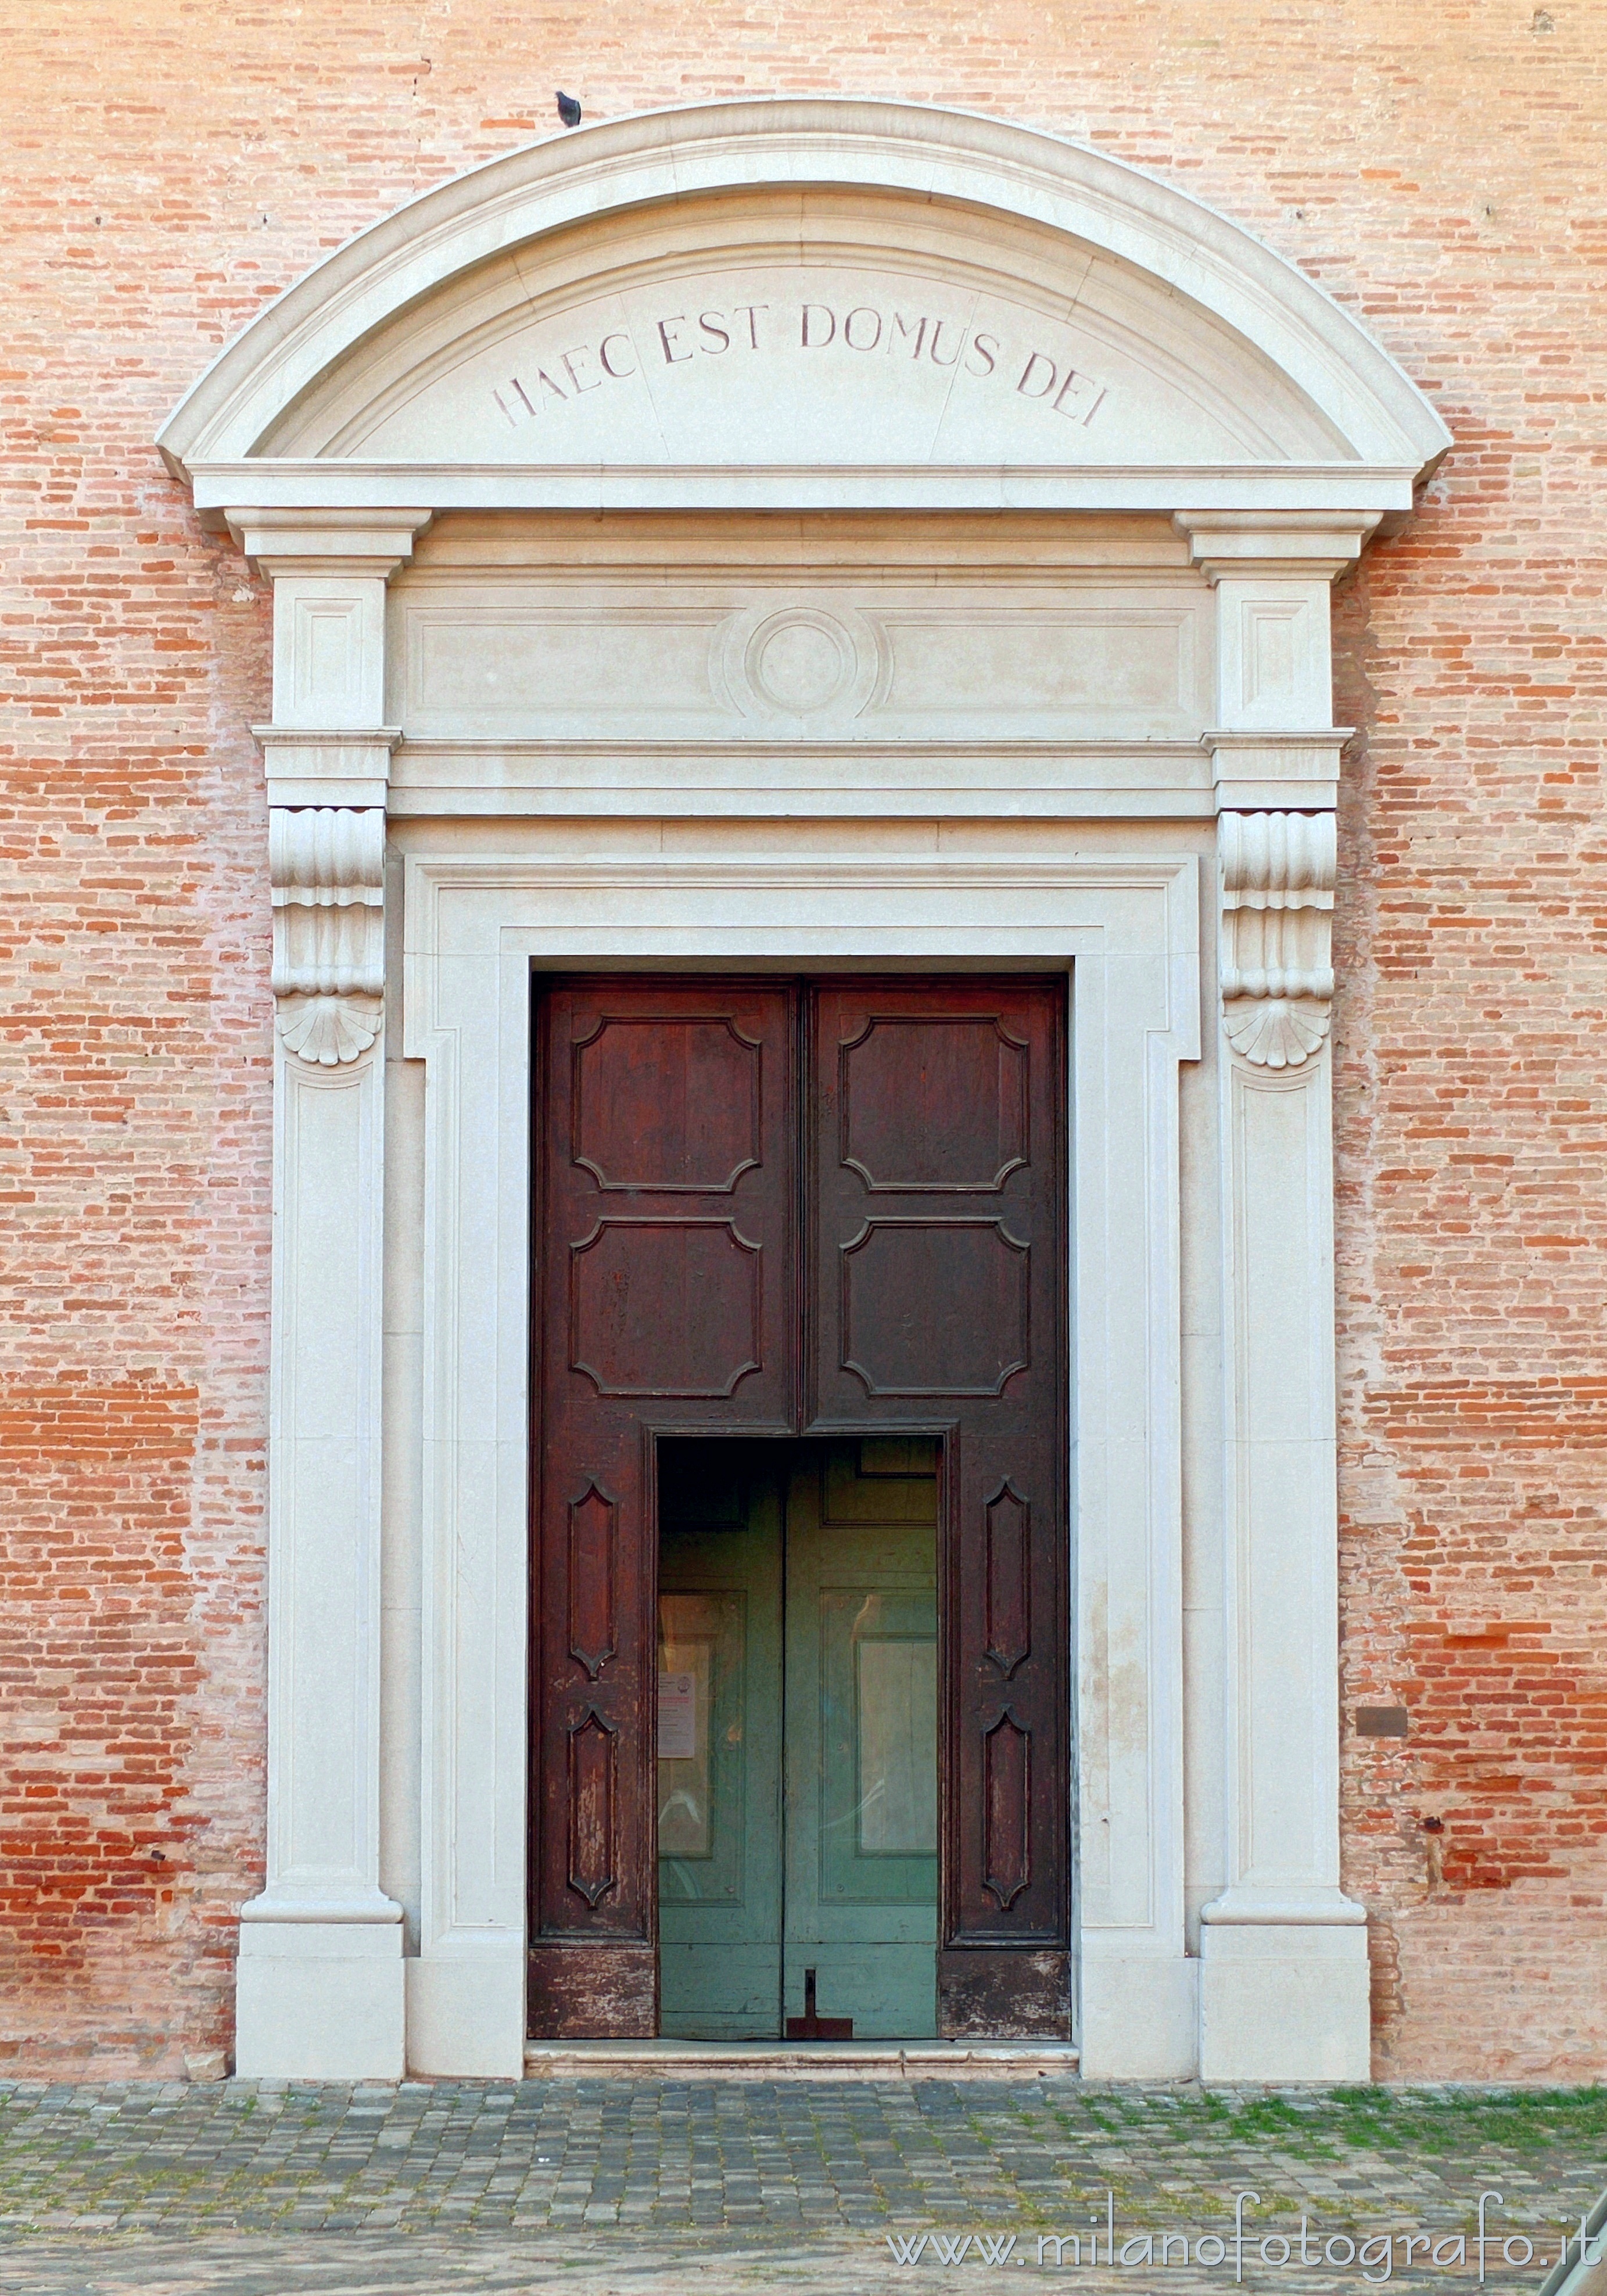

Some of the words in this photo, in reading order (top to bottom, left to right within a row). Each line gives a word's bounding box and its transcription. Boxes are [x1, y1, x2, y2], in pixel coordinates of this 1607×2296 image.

[492, 334, 637, 428] HAEC
[657, 304, 769, 364] EST
[801, 304, 1000, 376] DOMUS
[1017, 352, 1110, 427] DEI
